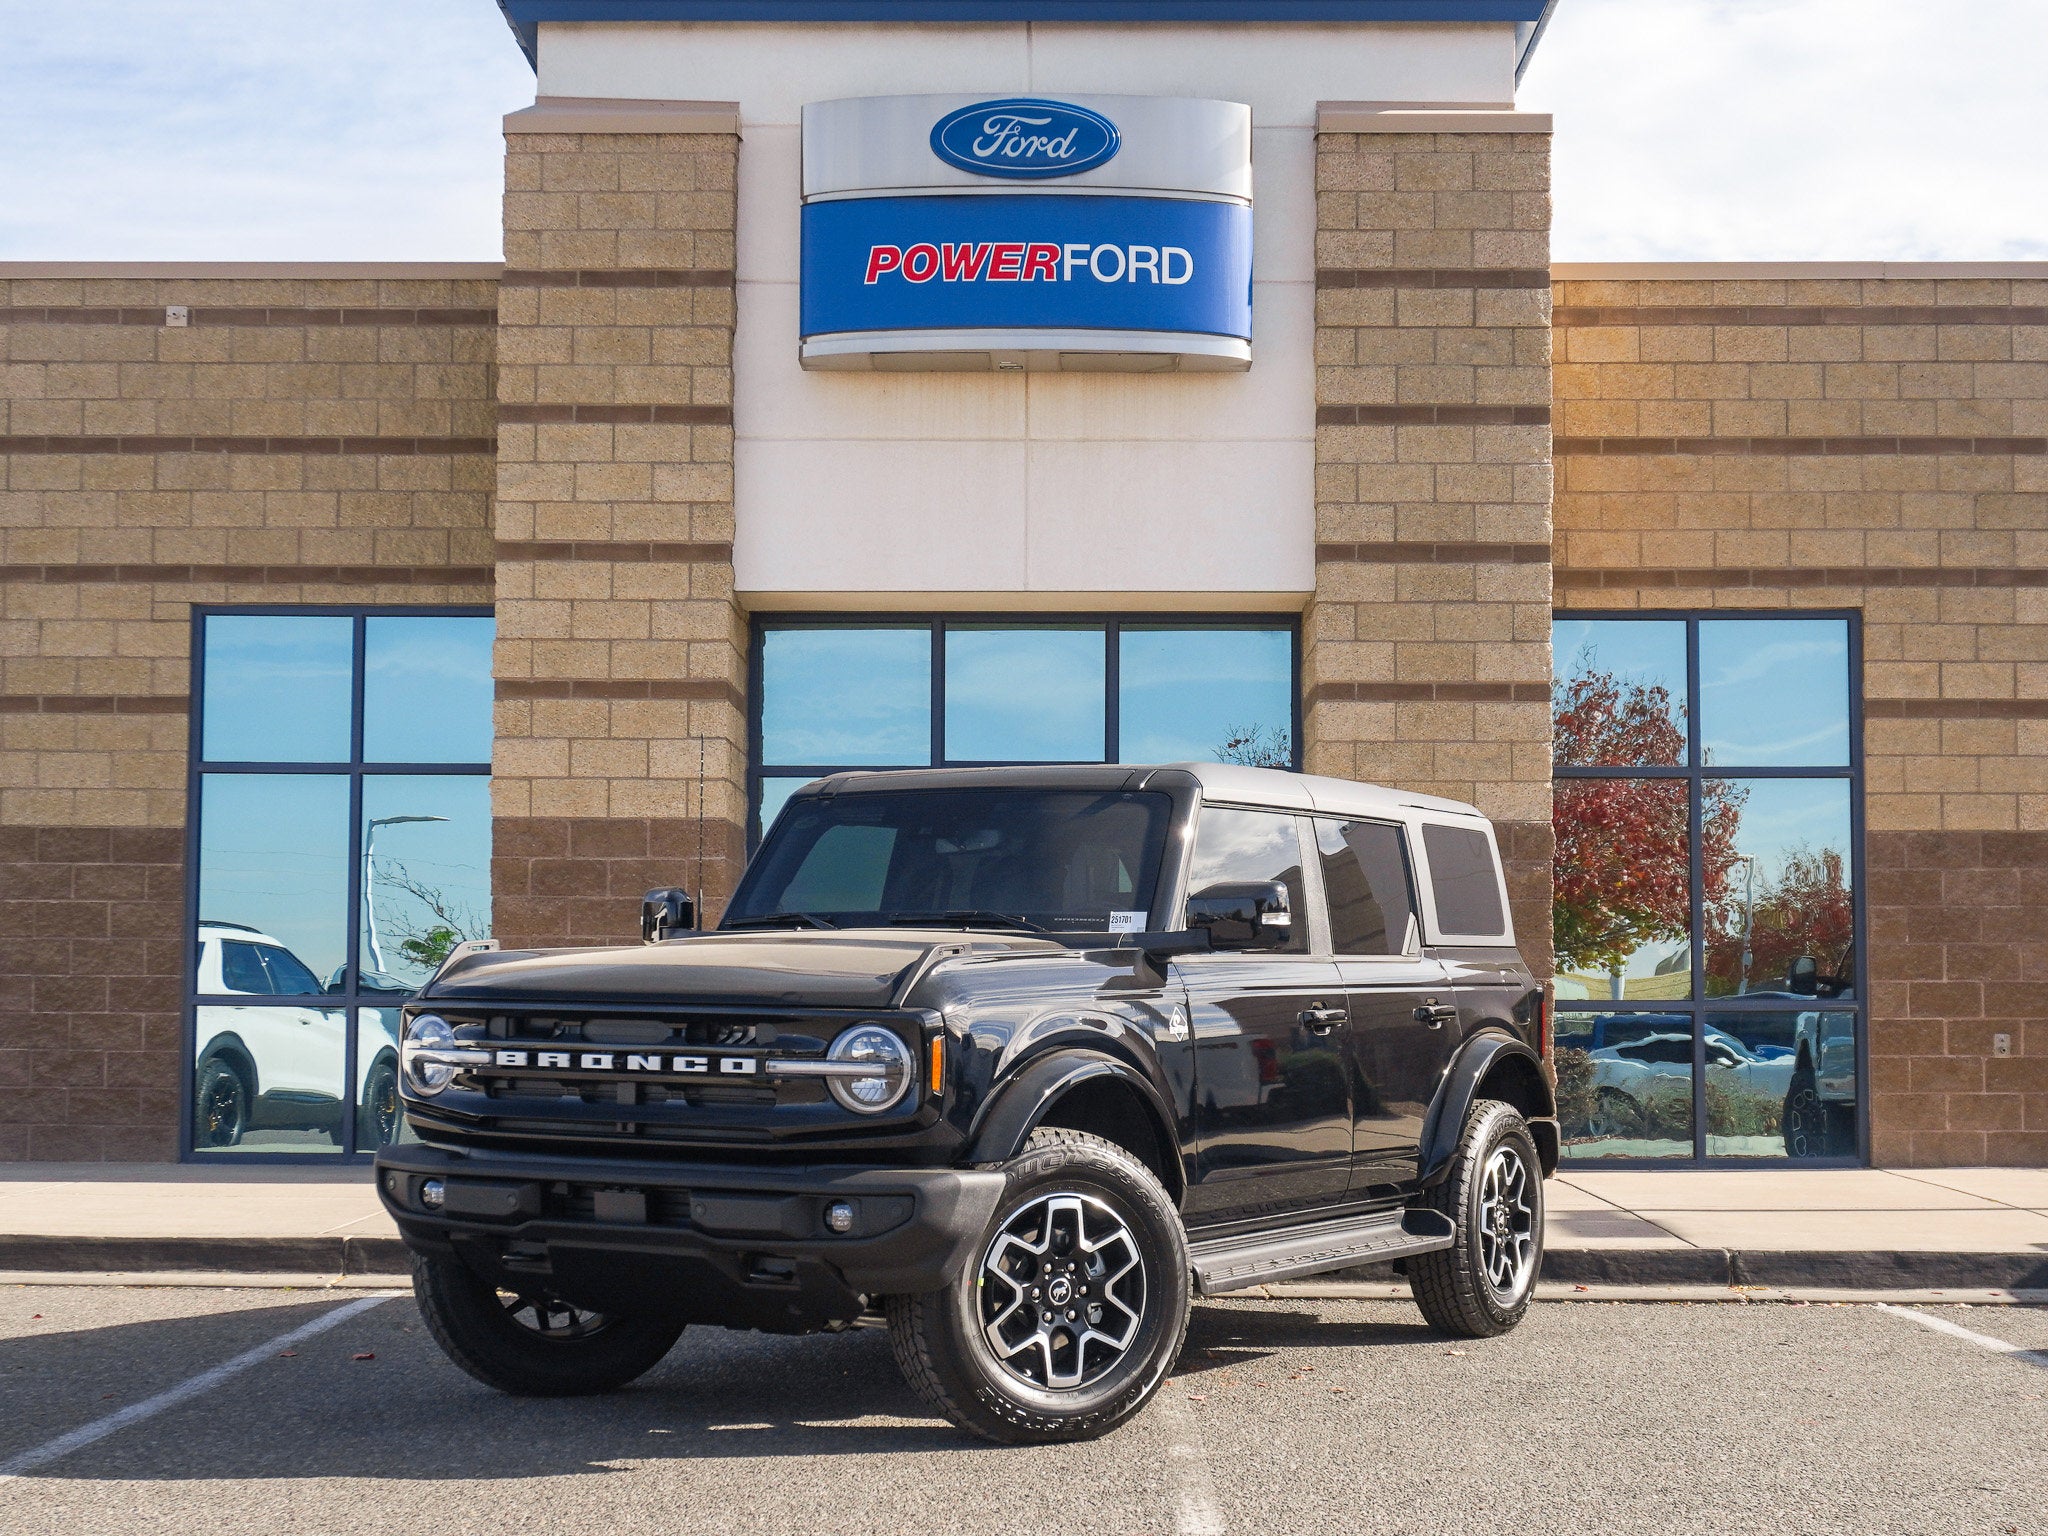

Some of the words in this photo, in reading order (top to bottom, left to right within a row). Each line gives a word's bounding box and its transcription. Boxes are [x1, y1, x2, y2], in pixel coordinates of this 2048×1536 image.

[972, 114, 1079, 159] Ford
[1111, 915, 1132, 924] 251701
[496, 1051, 757, 1074] BRONCO
